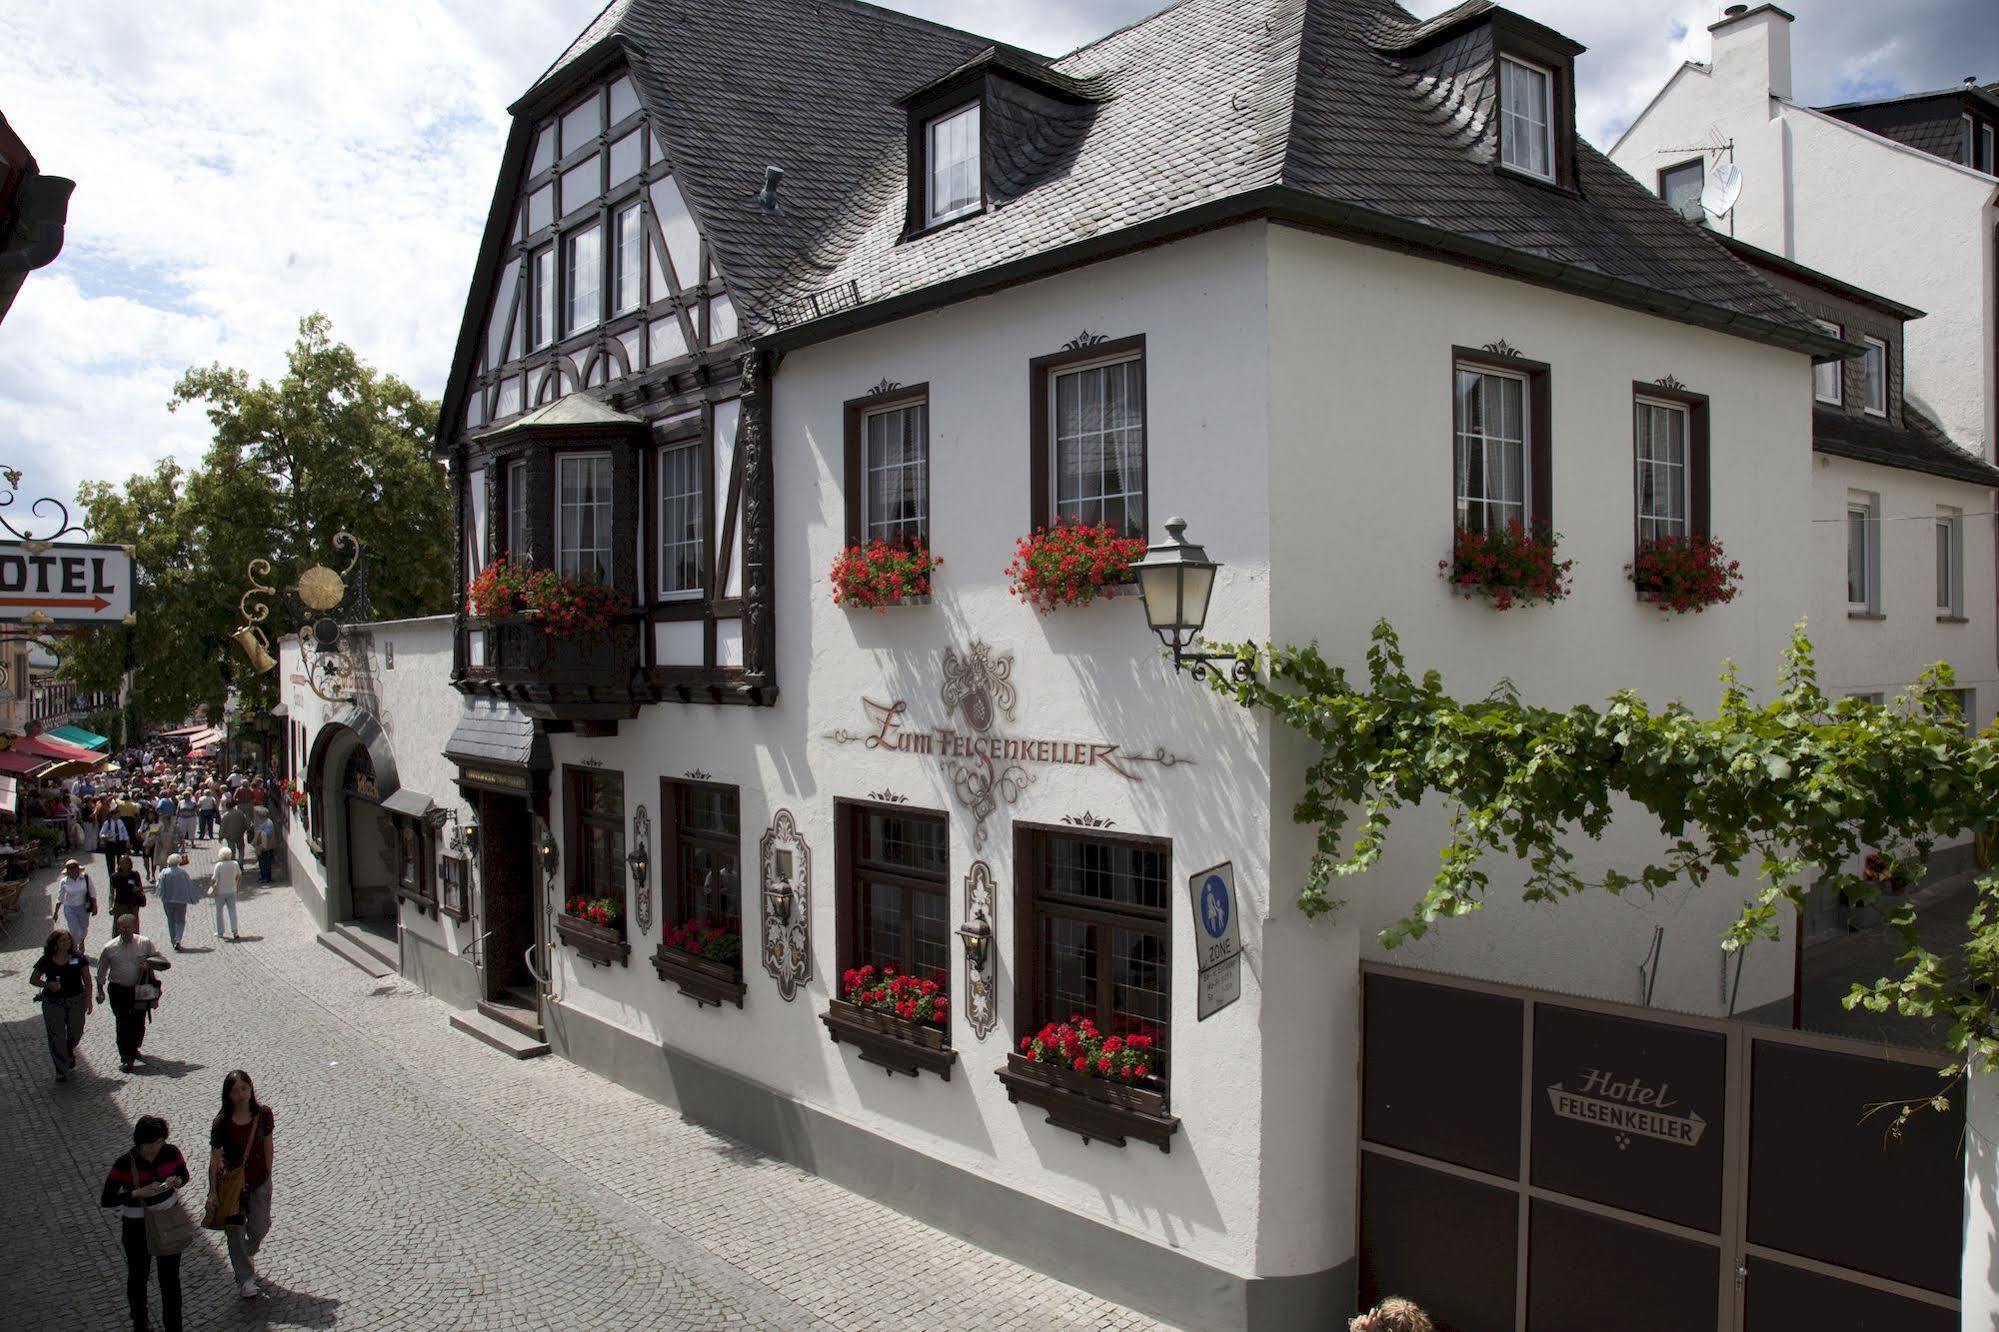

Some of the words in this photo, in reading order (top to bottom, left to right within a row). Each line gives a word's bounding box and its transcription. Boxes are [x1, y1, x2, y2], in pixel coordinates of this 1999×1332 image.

[864, 697, 933, 755] Zum
[1208, 938, 1231, 962] ZONE
[1577, 1066, 1679, 1109] Hotel
[1559, 1096, 1693, 1142] FELSENKELLER
